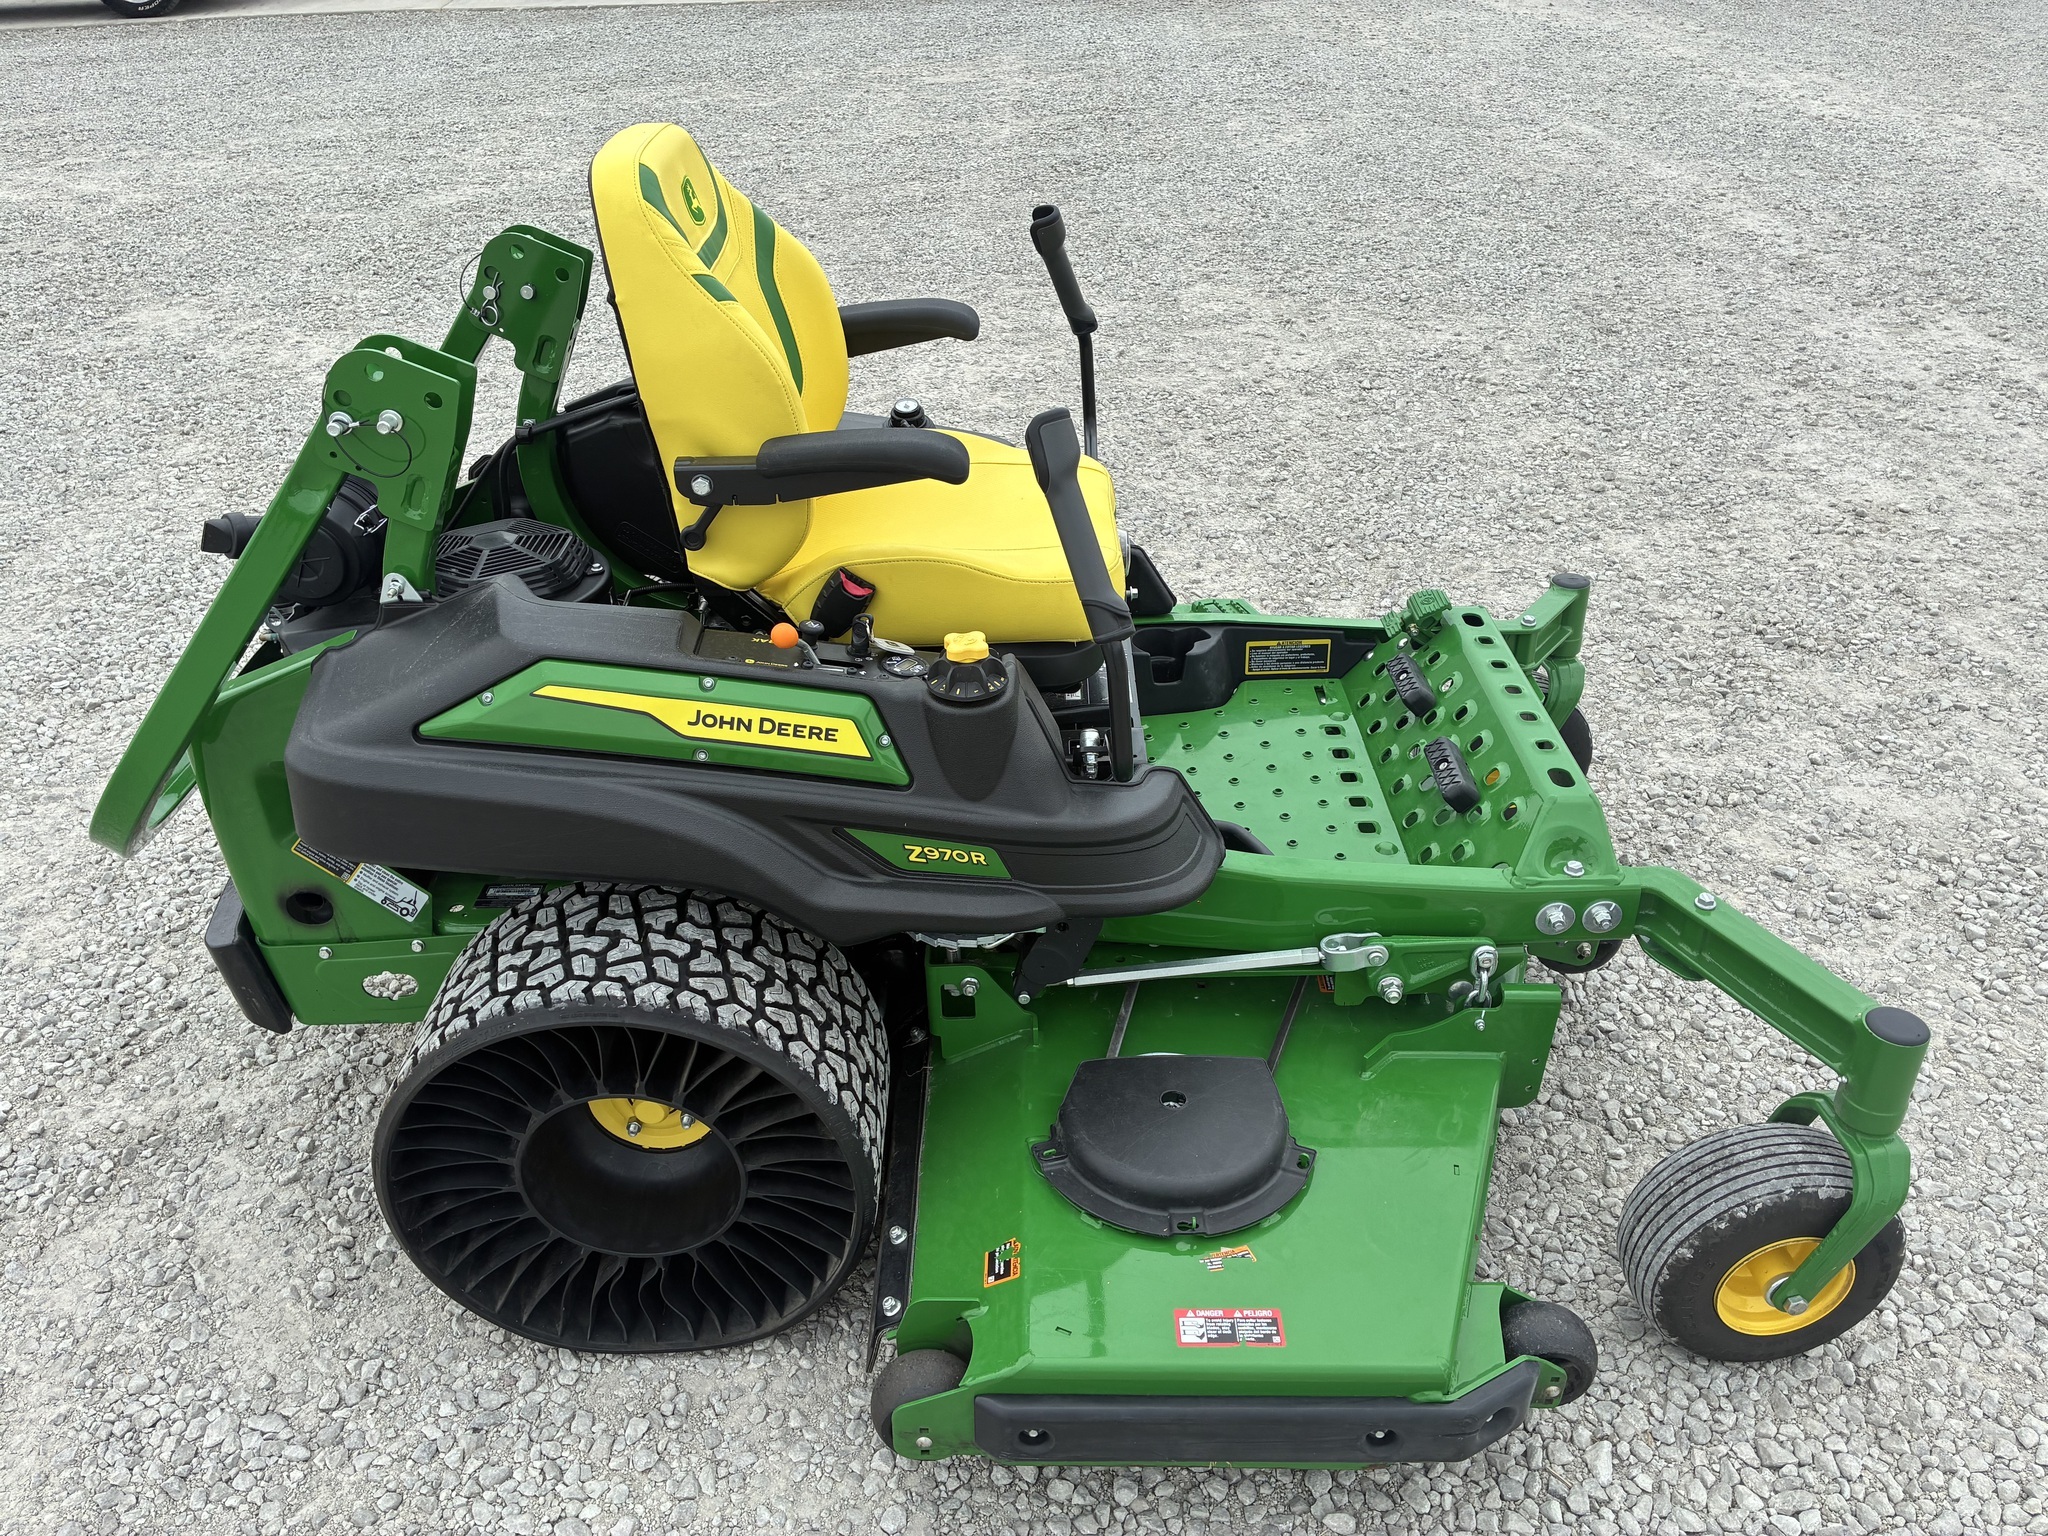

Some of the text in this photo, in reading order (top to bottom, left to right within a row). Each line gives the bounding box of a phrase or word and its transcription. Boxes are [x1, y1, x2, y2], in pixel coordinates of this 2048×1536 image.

[688, 710, 839, 742] JOHN DEERE
[904, 844, 988, 866] Z970R
